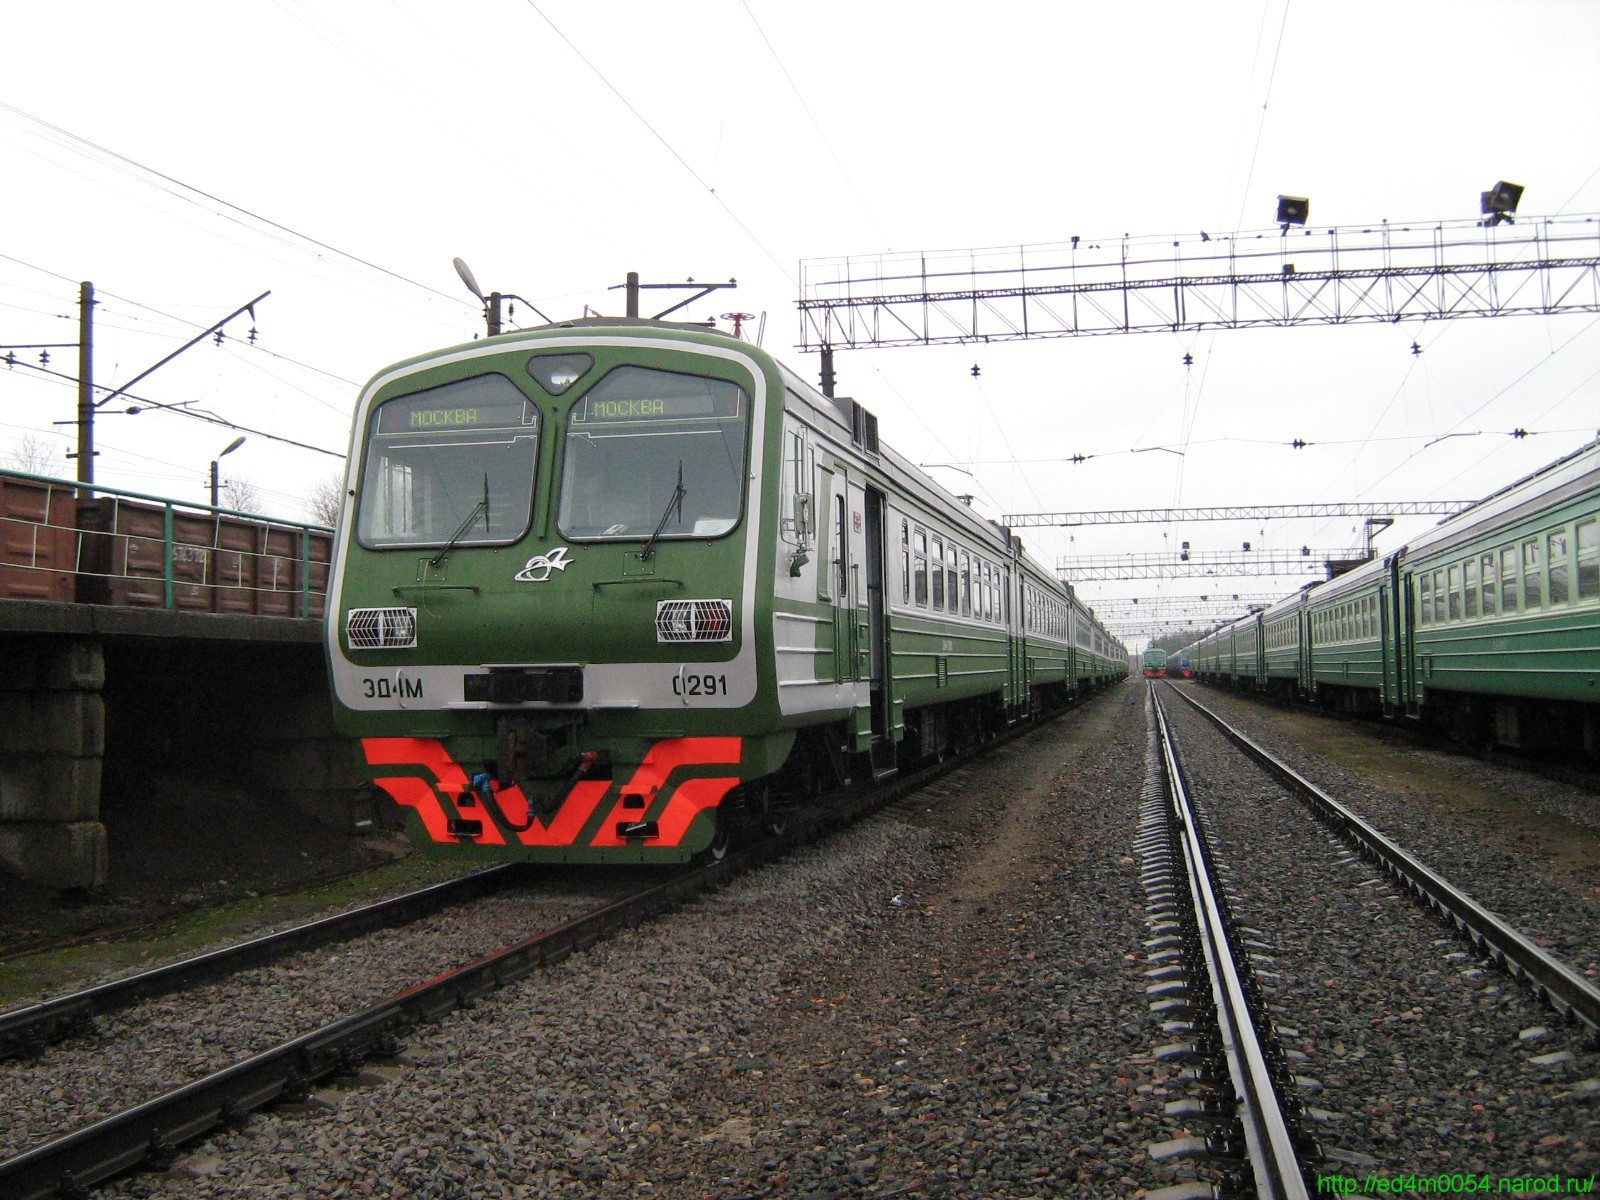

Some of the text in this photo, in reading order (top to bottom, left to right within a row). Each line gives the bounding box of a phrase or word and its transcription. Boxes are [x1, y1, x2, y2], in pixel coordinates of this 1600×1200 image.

[410, 408, 478, 427] МОСКВА
[594, 399, 665, 417] МОСКВА
[672, 674, 727, 696] 0291
